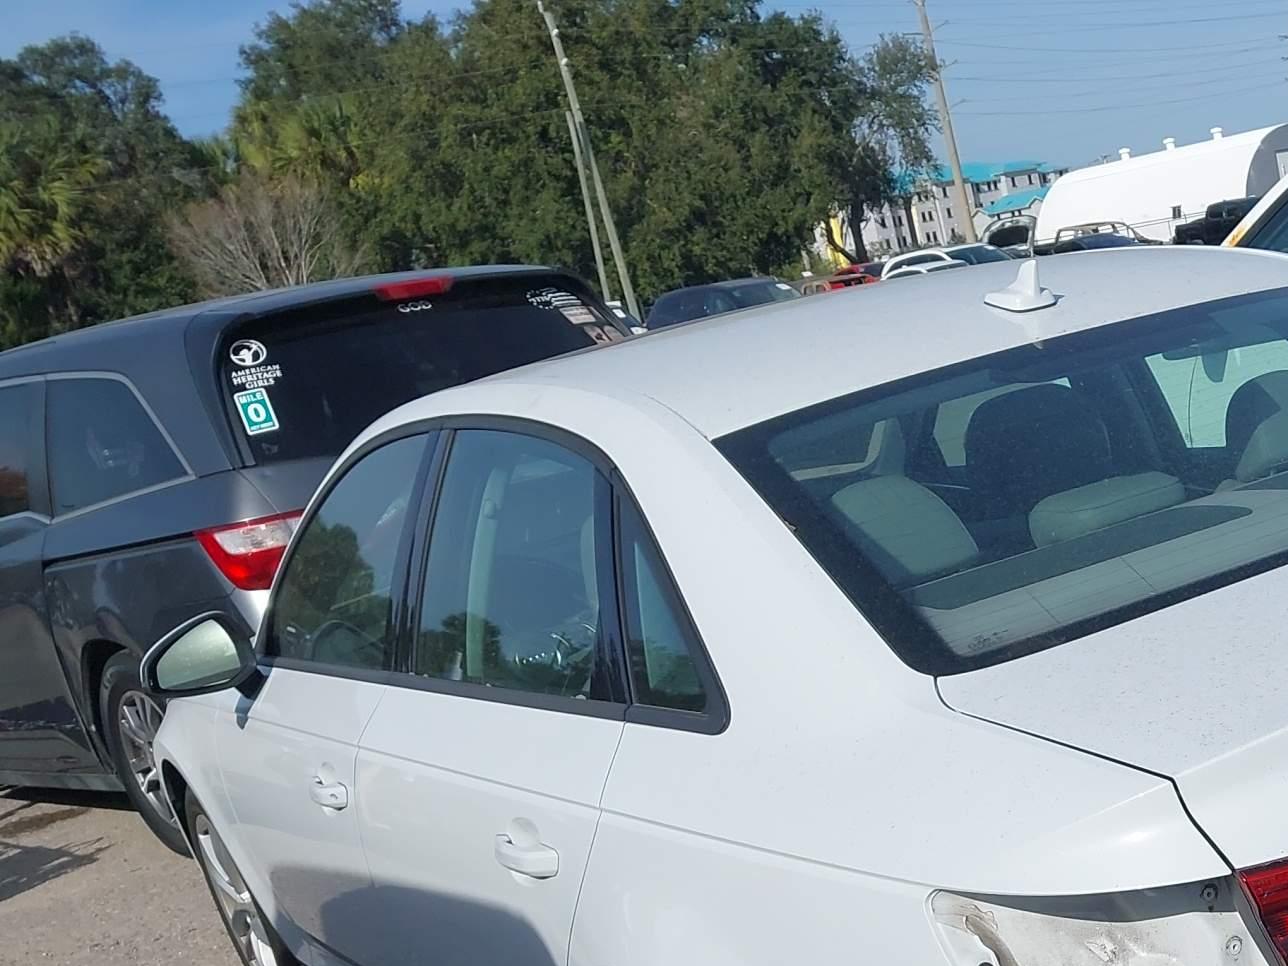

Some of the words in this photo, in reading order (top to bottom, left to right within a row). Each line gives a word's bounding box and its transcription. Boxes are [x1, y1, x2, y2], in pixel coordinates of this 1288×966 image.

[231, 364, 280, 378] AMERICAN
[232, 370, 282, 386] HERITAGE
[245, 378, 275, 389] GIRLS
[238, 392, 264, 404] MILE
[247, 403, 266, 423] 0
